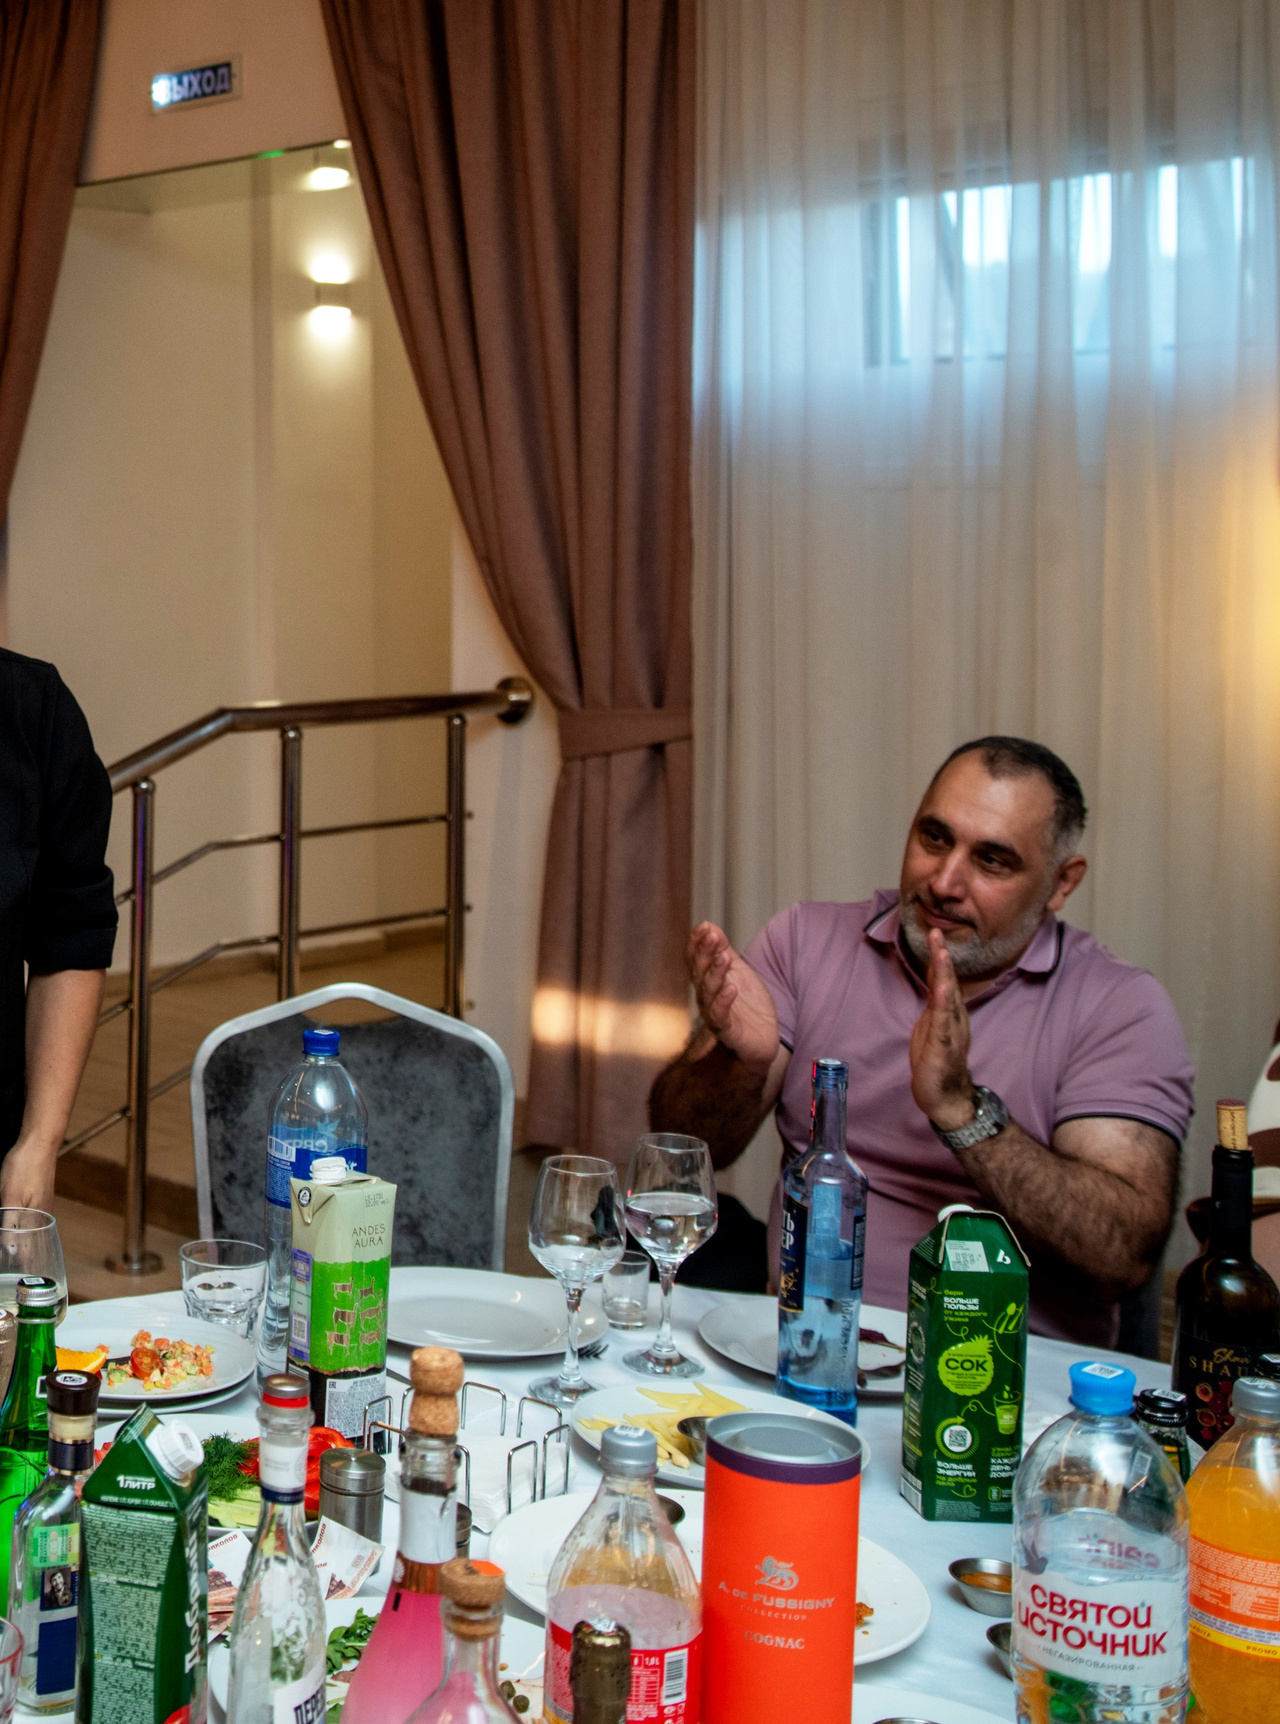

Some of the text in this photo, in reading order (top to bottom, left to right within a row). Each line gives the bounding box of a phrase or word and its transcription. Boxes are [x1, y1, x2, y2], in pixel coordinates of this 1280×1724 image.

[351, 1224, 386, 1238] ANDES
[354, 1237, 384, 1249] AURA
[943, 1296, 980, 1305] БОЛЬШЕ
[943, 1303, 980, 1311] ПОЛЬЗЫ
[945, 1358, 989, 1373] СОК
[936, 1460, 973, 1471] БОЛЬШЕ
[732, 1588, 749, 1600] DE
[753, 1593, 836, 1611] FUSSIGNY
[1030, 1584, 1152, 1629] СВЯТОЙ
[741, 1604, 807, 1621] COLLECTION
[1018, 1600, 1168, 1657] ИСТОЧНИК
[744, 1630, 805, 1650] COGNAC
[1041, 1645, 1136, 1672] НЕГАЗИРОВАННАЯ
[1246, 1645, 1279, 1657] PROMO
